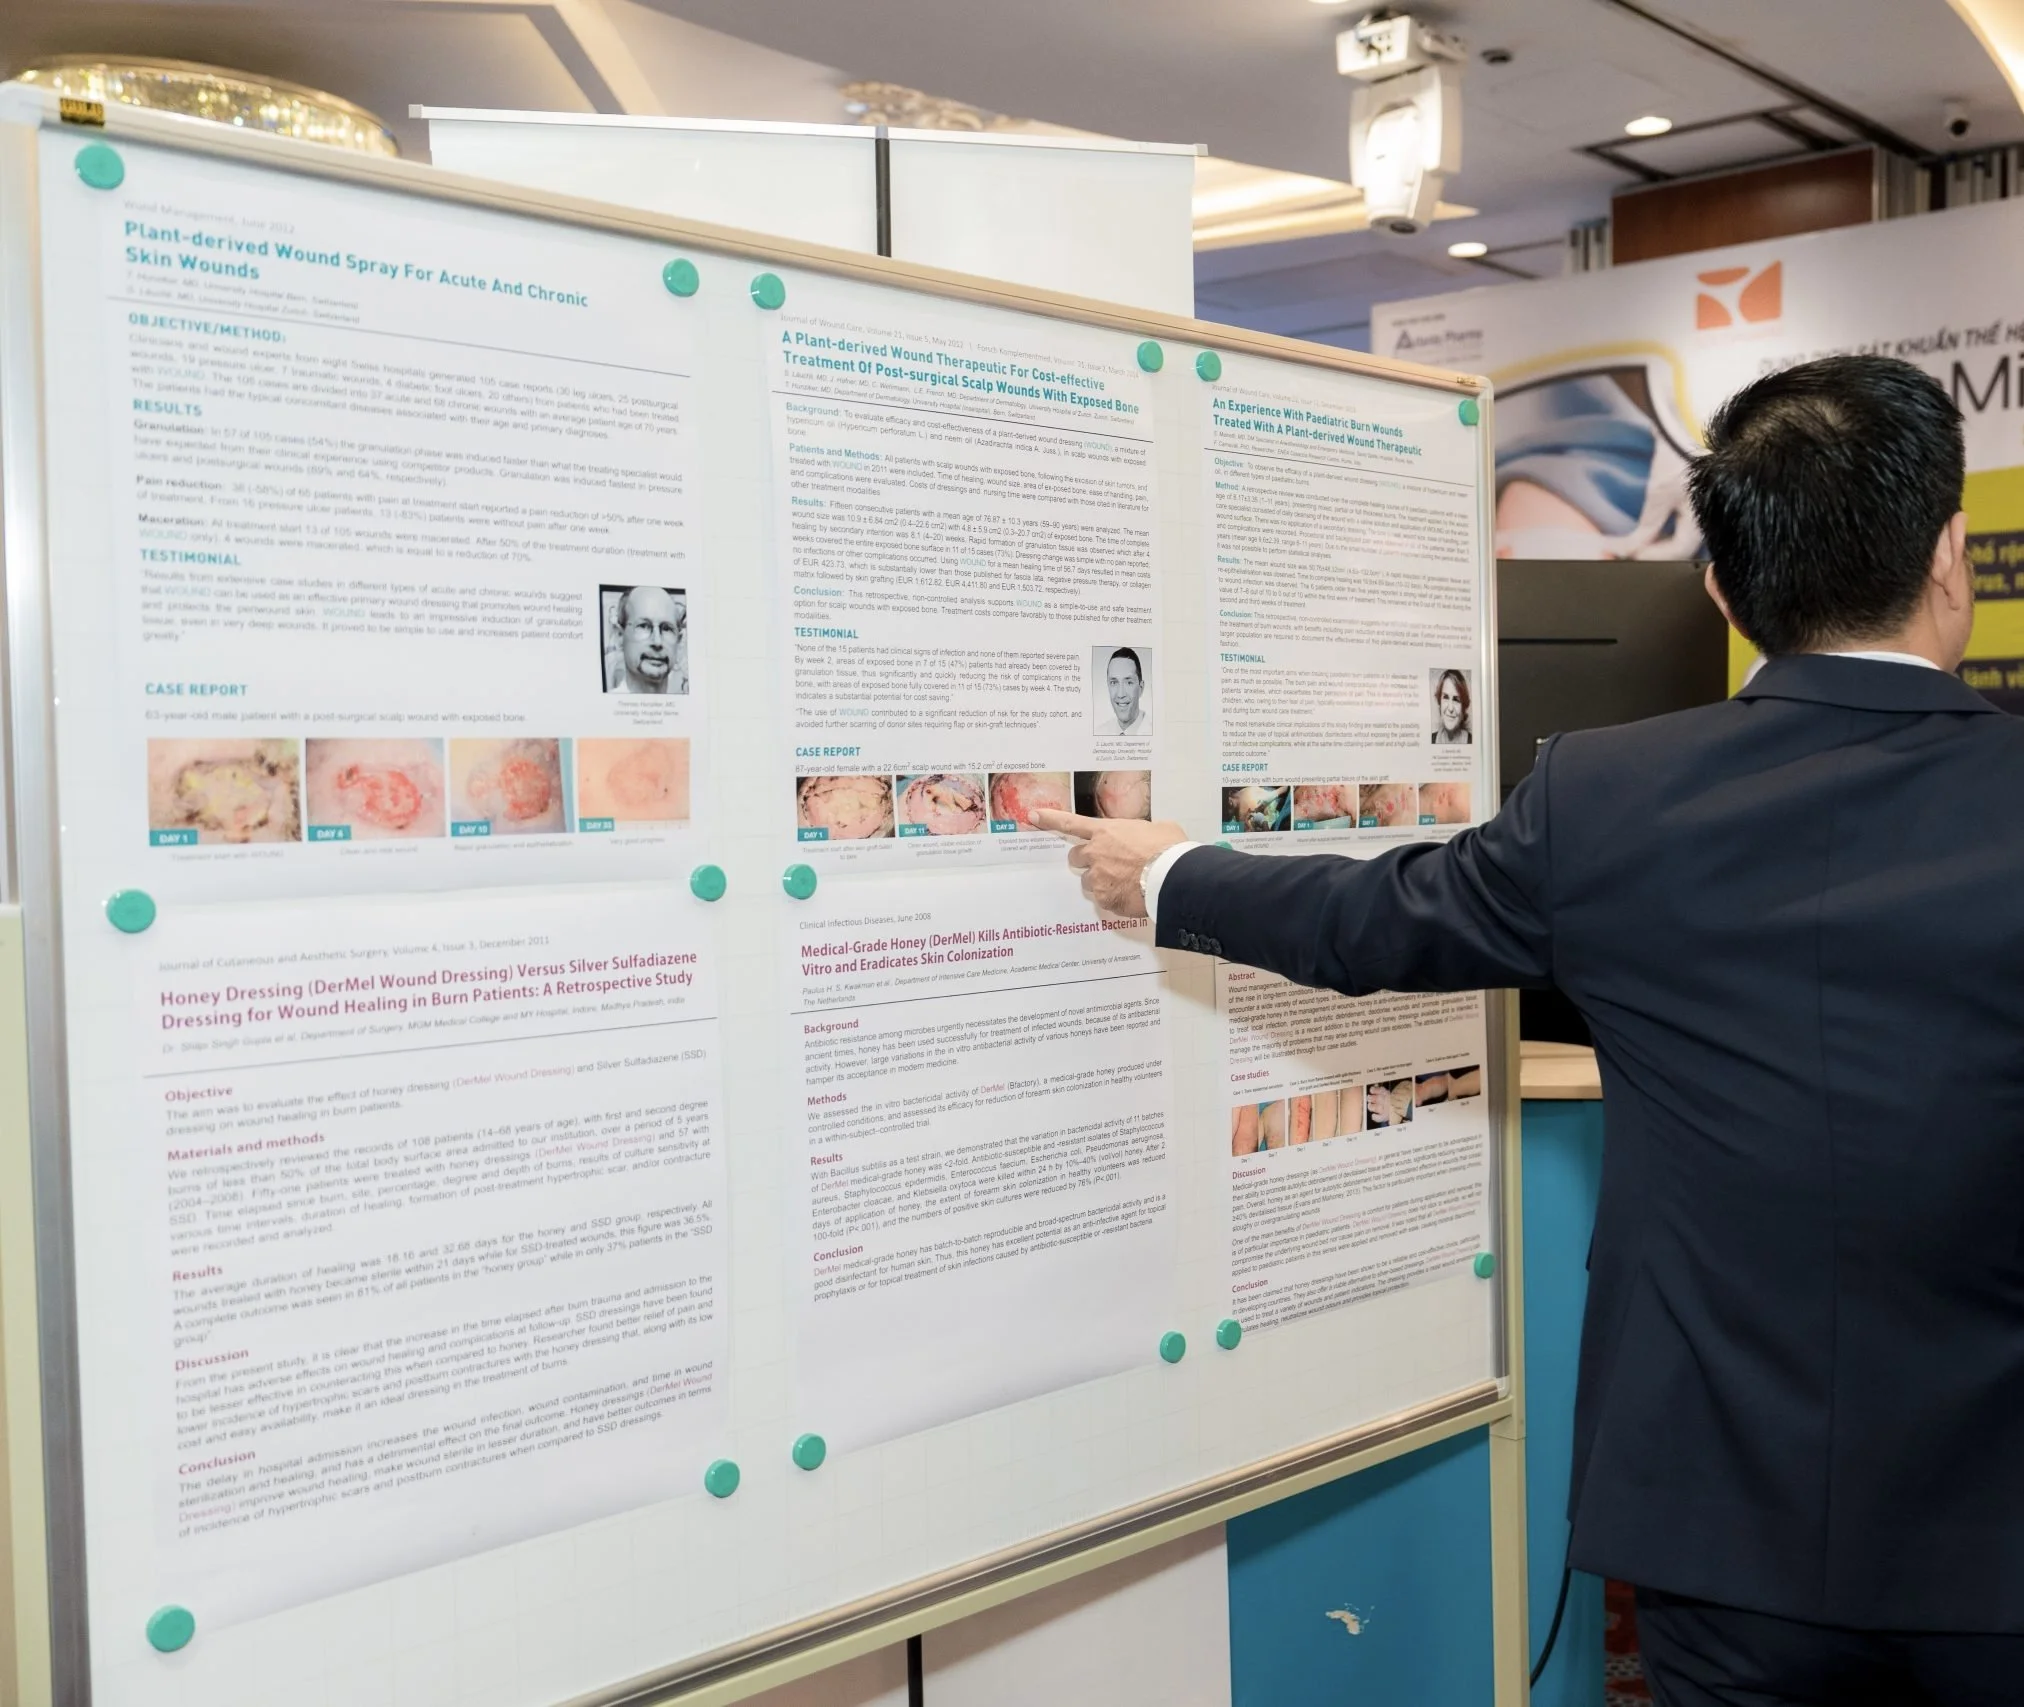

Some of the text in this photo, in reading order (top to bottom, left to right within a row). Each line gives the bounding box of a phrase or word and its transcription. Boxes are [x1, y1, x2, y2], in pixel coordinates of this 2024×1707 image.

[124, 221, 587, 306] Plant-derived Wound Spray For Acute And Chronic
[126, 246, 259, 279] Skin Wounds
[128, 313, 285, 341] OBJECTIVE/METHOD:
[782, 330, 1104, 390] A Plant-derived Wound Therapeutic For Cost-effective
[783, 350, 1138, 413] Treatment Of Post-surgical Scalp Wounds With Exposed Bone
[132, 399, 202, 416] RESULTS
[786, 402, 841, 416] Background:
[1212, 398, 1225, 409] An
[1228, 399, 1281, 417] Experience
[1283, 408, 1303, 420] With
[1306, 411, 1348, 428] Paediatric
[1350, 419, 1370, 431] Burn
[1372, 424, 1402, 437] Wounds
[1213, 414, 1421, 455] Treated With A Plant-derived Wound Therapeutic
[789, 442, 882, 460] Patients and Methods:
[1214, 457, 1244, 467] Objective:
[1215, 481, 1238, 490] Method:
[791, 496, 825, 507] Results:
[141, 549, 240, 564] TESTIMONIAL
[1216, 555, 1244, 564] Results:
[793, 585, 844, 596] Conclusion:
[1219, 609, 1255, 617] Conclusion:
[794, 627, 858, 638] TESTIMONIAL
[1220, 653, 1265, 662] TESTIMONIAL
[145, 683, 246, 695] CASE REPORT
[795, 746, 860, 756] CASE REPORT
[1222, 763, 1268, 771] CASE REPORT
[459, 825, 477, 834] DAY
[586, 822, 601, 830] DAY
[158, 834, 188, 844] DAY 1
[316, 829, 336, 840] DAY
[804, 831, 818, 839] DAY
[799, 920, 825, 929] Clinical
[864, 916, 896, 924] Diseases,
[914, 912, 931, 920] 2008
[801, 918, 1148, 957] Medical-Grade Honey (DerMel) Kills Antibiotic-Resistant Bacteria In
[802, 946, 1013, 976] Vitro and Eradicates Skin Colonization
[161, 953, 696, 1006] Honey Dressing (DerMel Wound Dressing) Versus Silver Sulfadiazene
[1228, 972, 1255, 980] Abstract
[162, 970, 692, 1029] Dressing for Wound Healing in Burn Patients: A Retrospective Study
[804, 1019, 858, 1033] Background
[806, 1075, 834, 1085] hamper
[846, 1068, 888, 1079] acceptance
[897, 1063, 924, 1072] modern
[926, 1058, 958, 1068] medicine.
[1246, 1069, 1269, 1079] studies
[164, 1087, 232, 1102] Objective
[807, 1092, 846, 1105] Methods
[167, 1132, 324, 1160] Materials and methods
[810, 1153, 843, 1165] Results
[1232, 1167, 1265, 1179] Discussion
[813, 1245, 863, 1261] Conclusion
[172, 1266, 222, 1281] Results
[1231, 1279, 1268, 1292] Conclusion
[175, 1350, 248, 1371] Discussion
[178, 1451, 255, 1474] Conclusion
